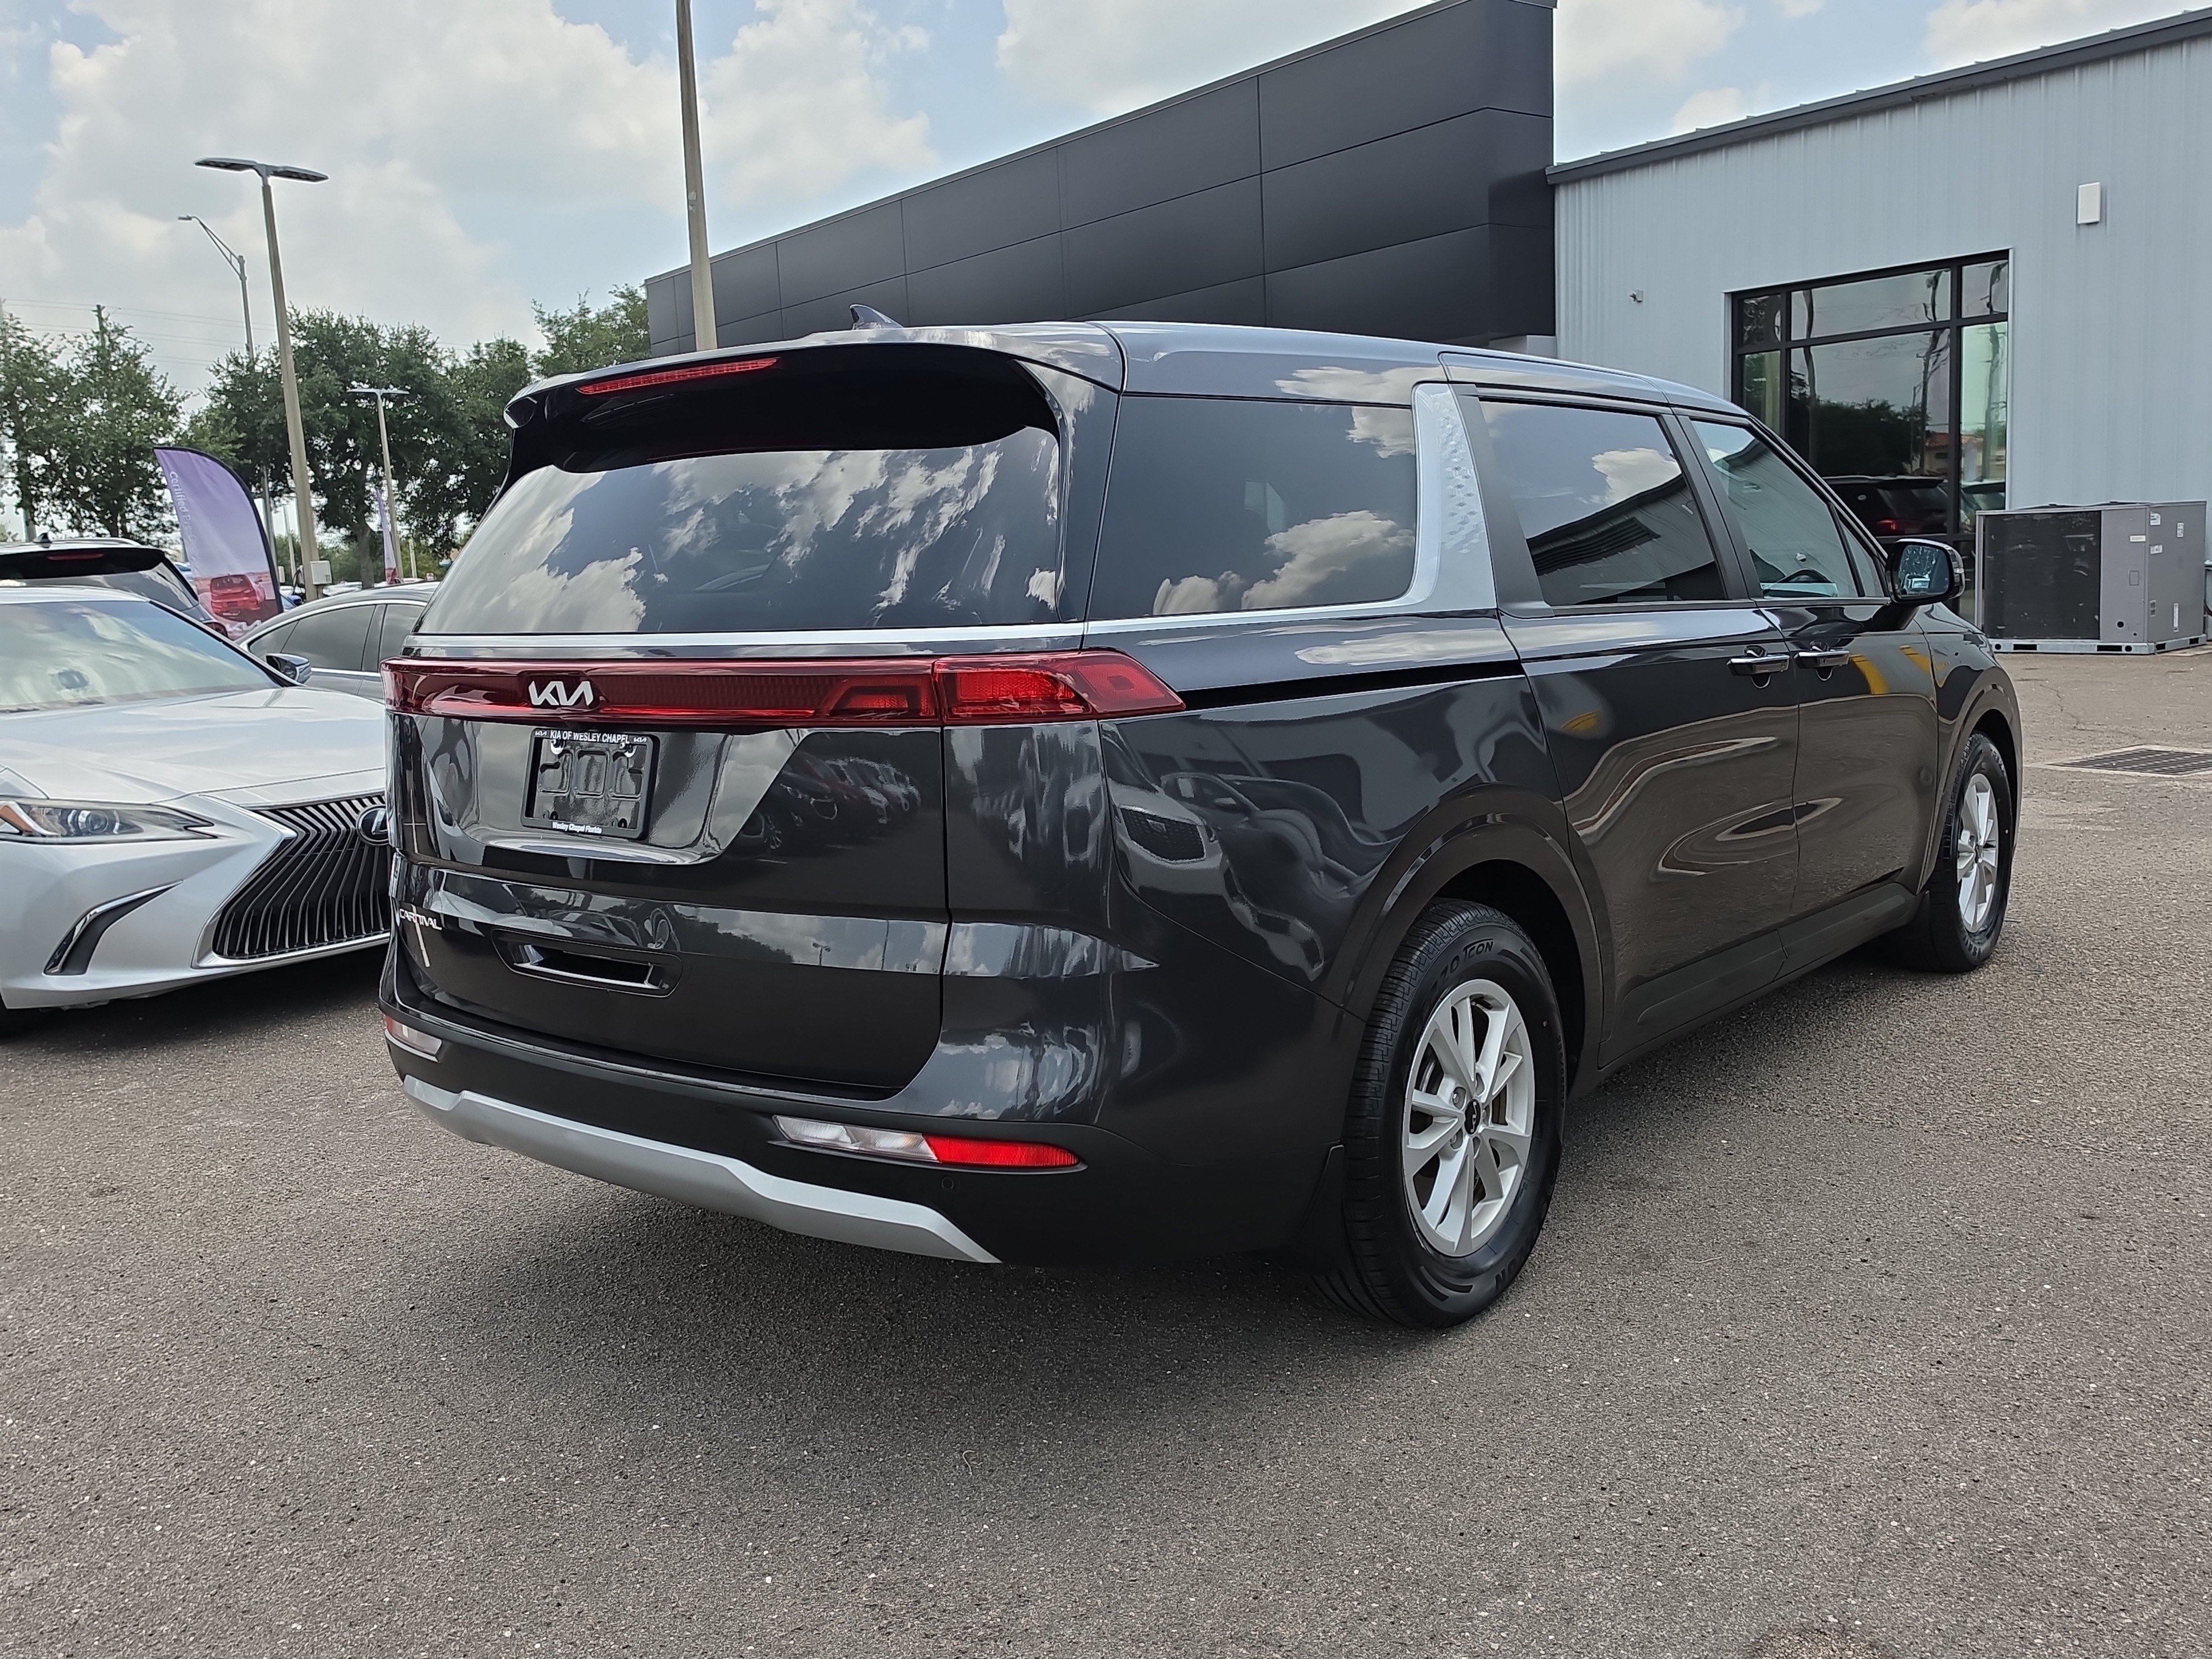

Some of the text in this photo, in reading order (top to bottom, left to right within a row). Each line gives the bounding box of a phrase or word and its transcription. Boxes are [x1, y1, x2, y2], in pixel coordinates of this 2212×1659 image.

[170, 471, 189, 512] Certified
[529, 681, 594, 706] KIA
[550, 730, 562, 740] KIA
[563, 731, 573, 741] OF
[573, 732, 601, 743] WESLEY
[602, 733, 630, 744] CHAPEL
